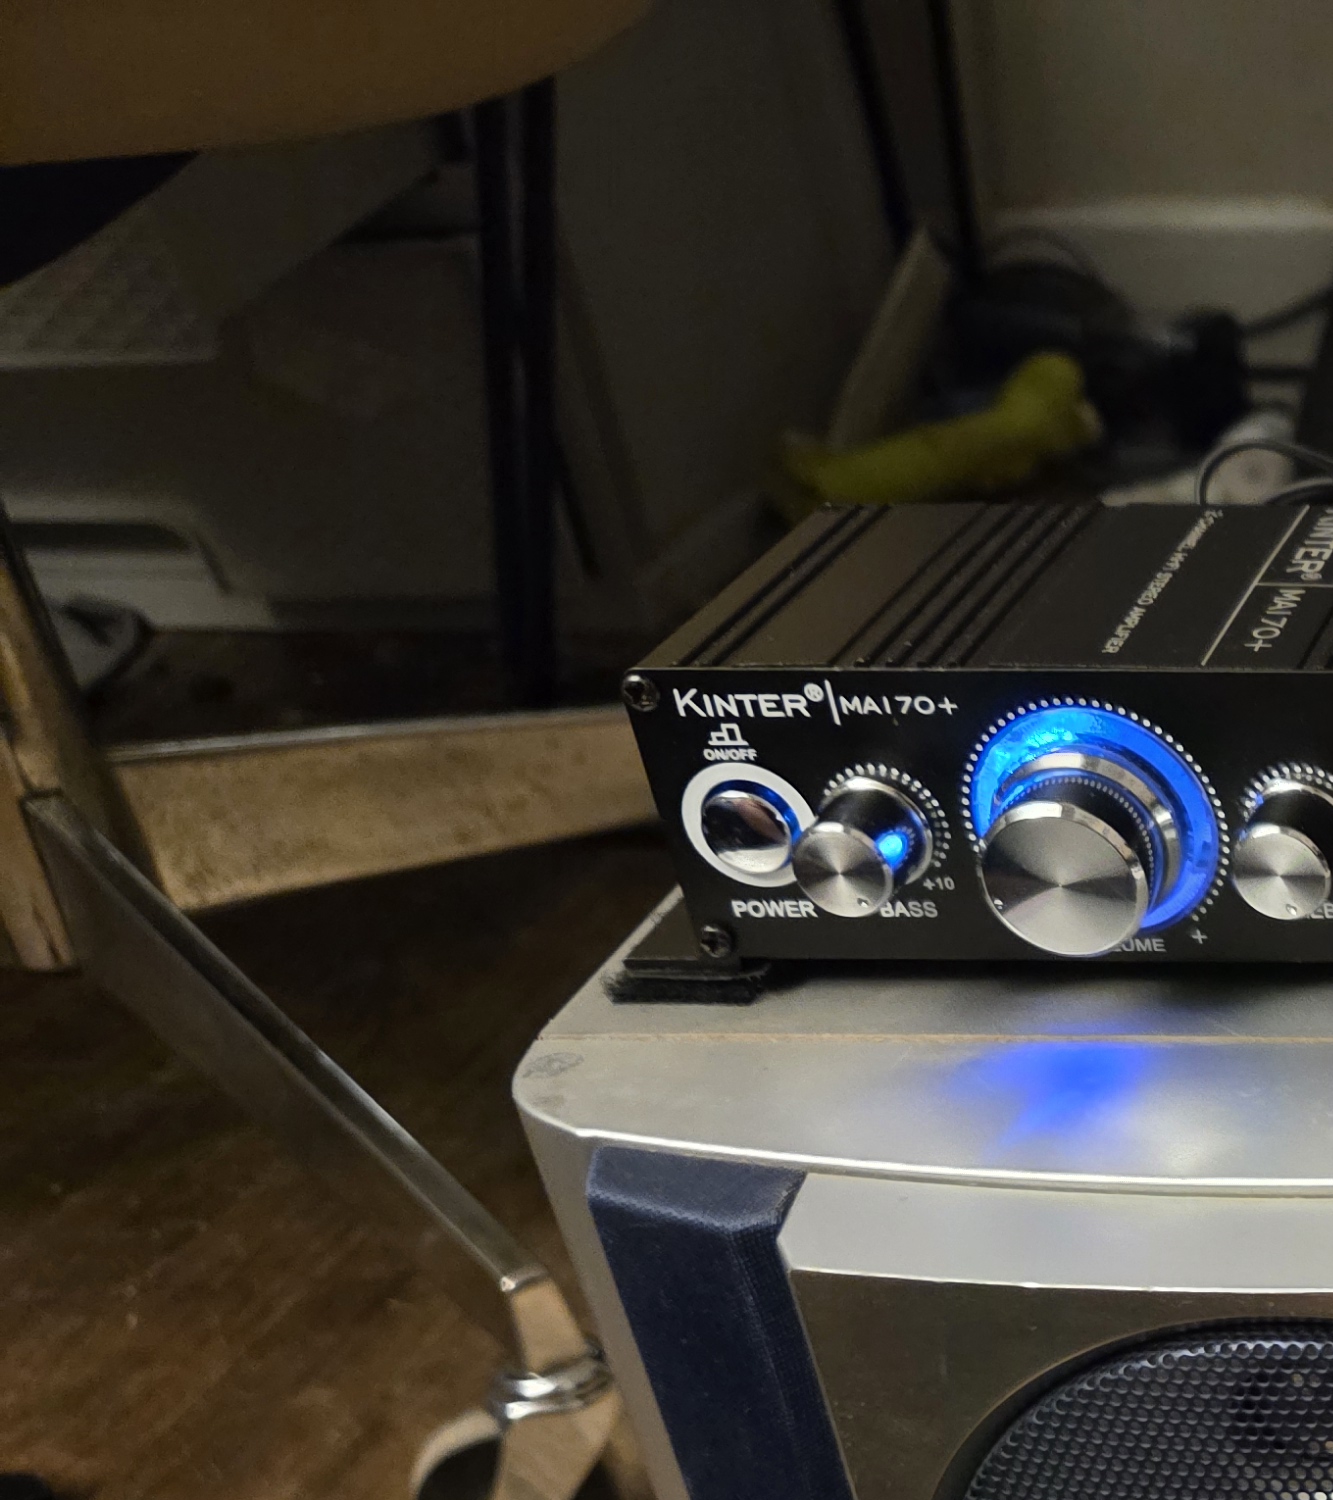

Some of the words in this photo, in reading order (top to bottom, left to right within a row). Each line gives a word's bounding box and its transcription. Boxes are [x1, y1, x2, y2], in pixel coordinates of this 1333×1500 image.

[1244, 588, 1306, 652] MA170+
[839, 695, 958, 716] MA170+
[702, 748, 758, 762] ON/OFF
[923, 876, 956, 891] +10
[731, 899, 819, 919] POWER
